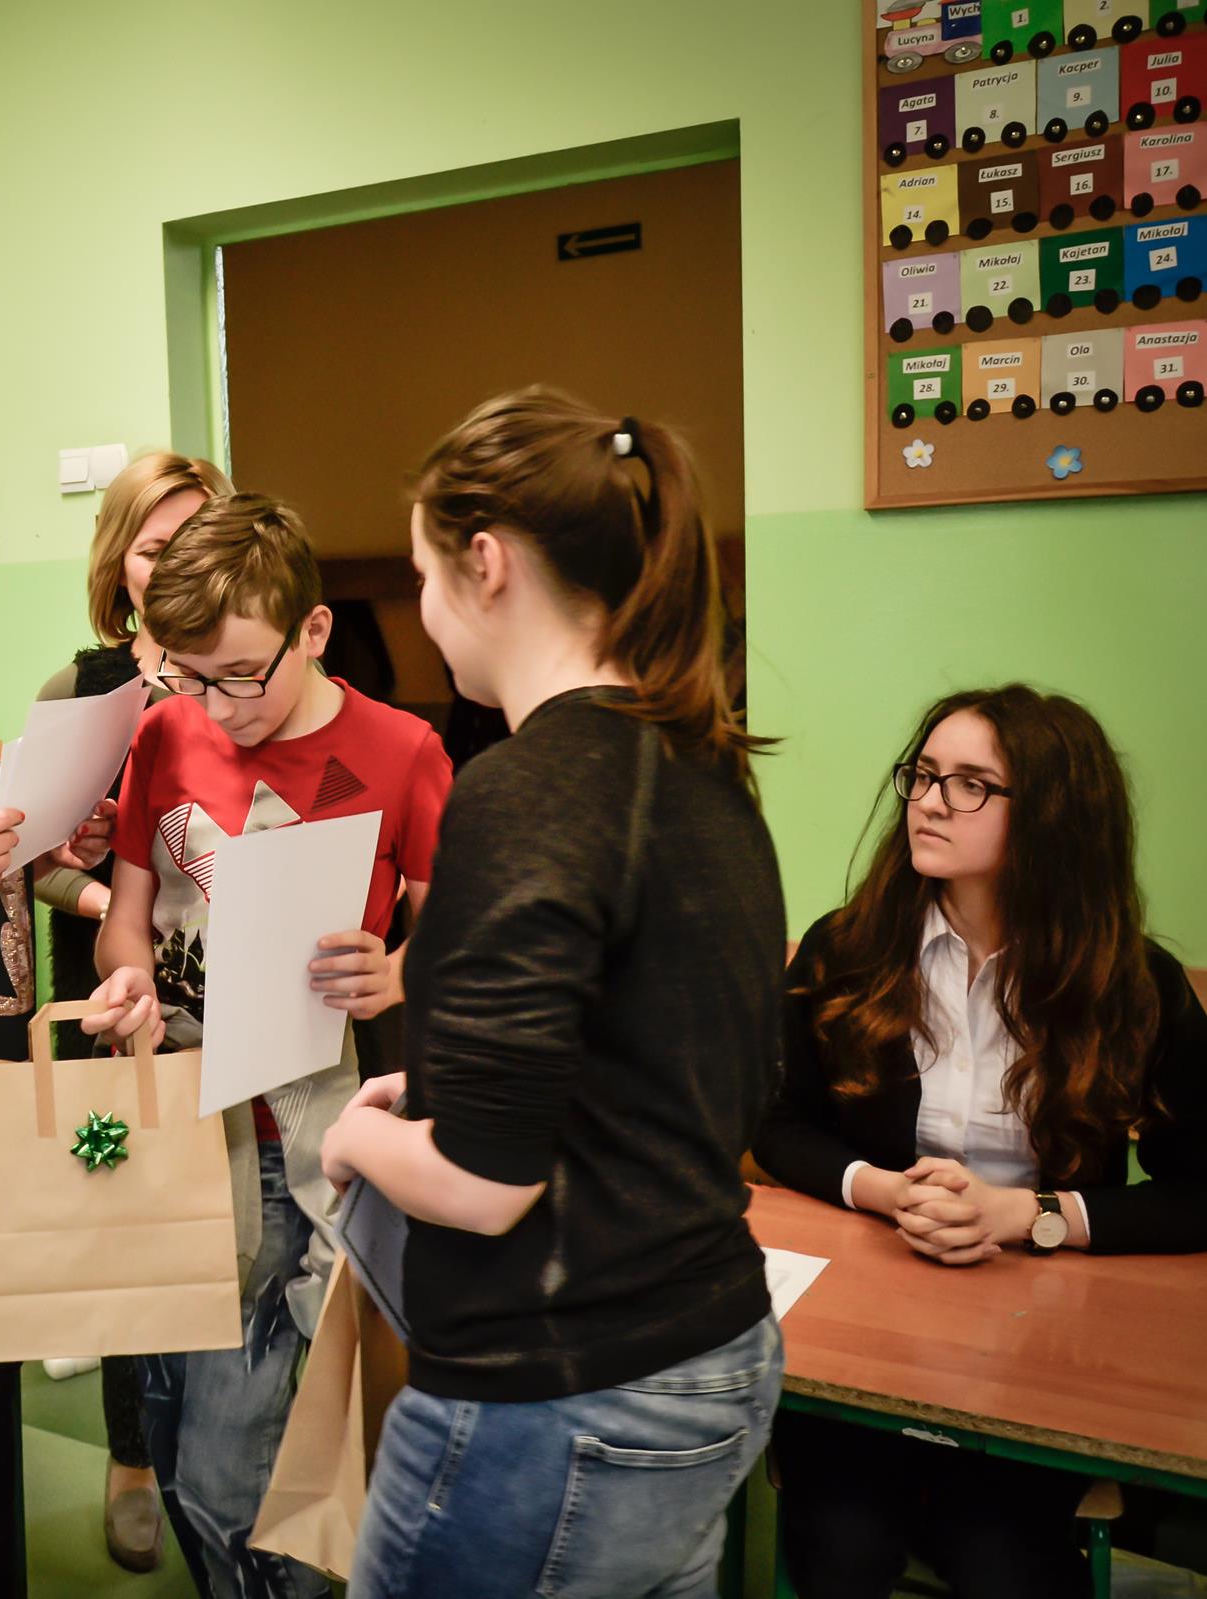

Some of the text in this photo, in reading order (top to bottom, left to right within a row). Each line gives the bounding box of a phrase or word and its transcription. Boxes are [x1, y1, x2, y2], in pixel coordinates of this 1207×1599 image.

[898, 33, 934, 46] Lucyna
[1150, 54, 1179, 66] Julia
[1058, 60, 1100, 74] Kacper
[972, 72, 1018, 88] Patrycja
[901, 95, 934, 110] Agata
[1141, 133, 1192, 147] Karolina
[1054, 148, 1102, 163] Sergiusz
[1155, 166, 1173, 177] 17.
[899, 176, 935, 188] Adrian
[1074, 180, 1091, 191] 16.
[995, 198, 1011, 208] 15.
[906, 210, 921, 220] 14.
[1138, 224, 1186, 240] Mikołaj
[1062, 246, 1106, 260] Kajetan
[978, 254, 1021, 268] Mikołaj
[1155, 254, 1173, 265] 24.
[901, 264, 935, 277] Oliwia
[1074, 275, 1091, 285] 23.
[993, 281, 1009, 291] 22.
[912, 298, 928, 308] 21.
[1137, 333, 1197, 346] Anastazja
[1070, 346, 1089, 356] Ola
[905, 358, 947, 371] Mikołaj
[981, 355, 1021, 366] Marcin
[1160, 364, 1177, 374] 31.
[1072, 376, 1089, 386] 30.
[919, 384, 935, 393] 28.
[993, 383, 1009, 393] 29.
